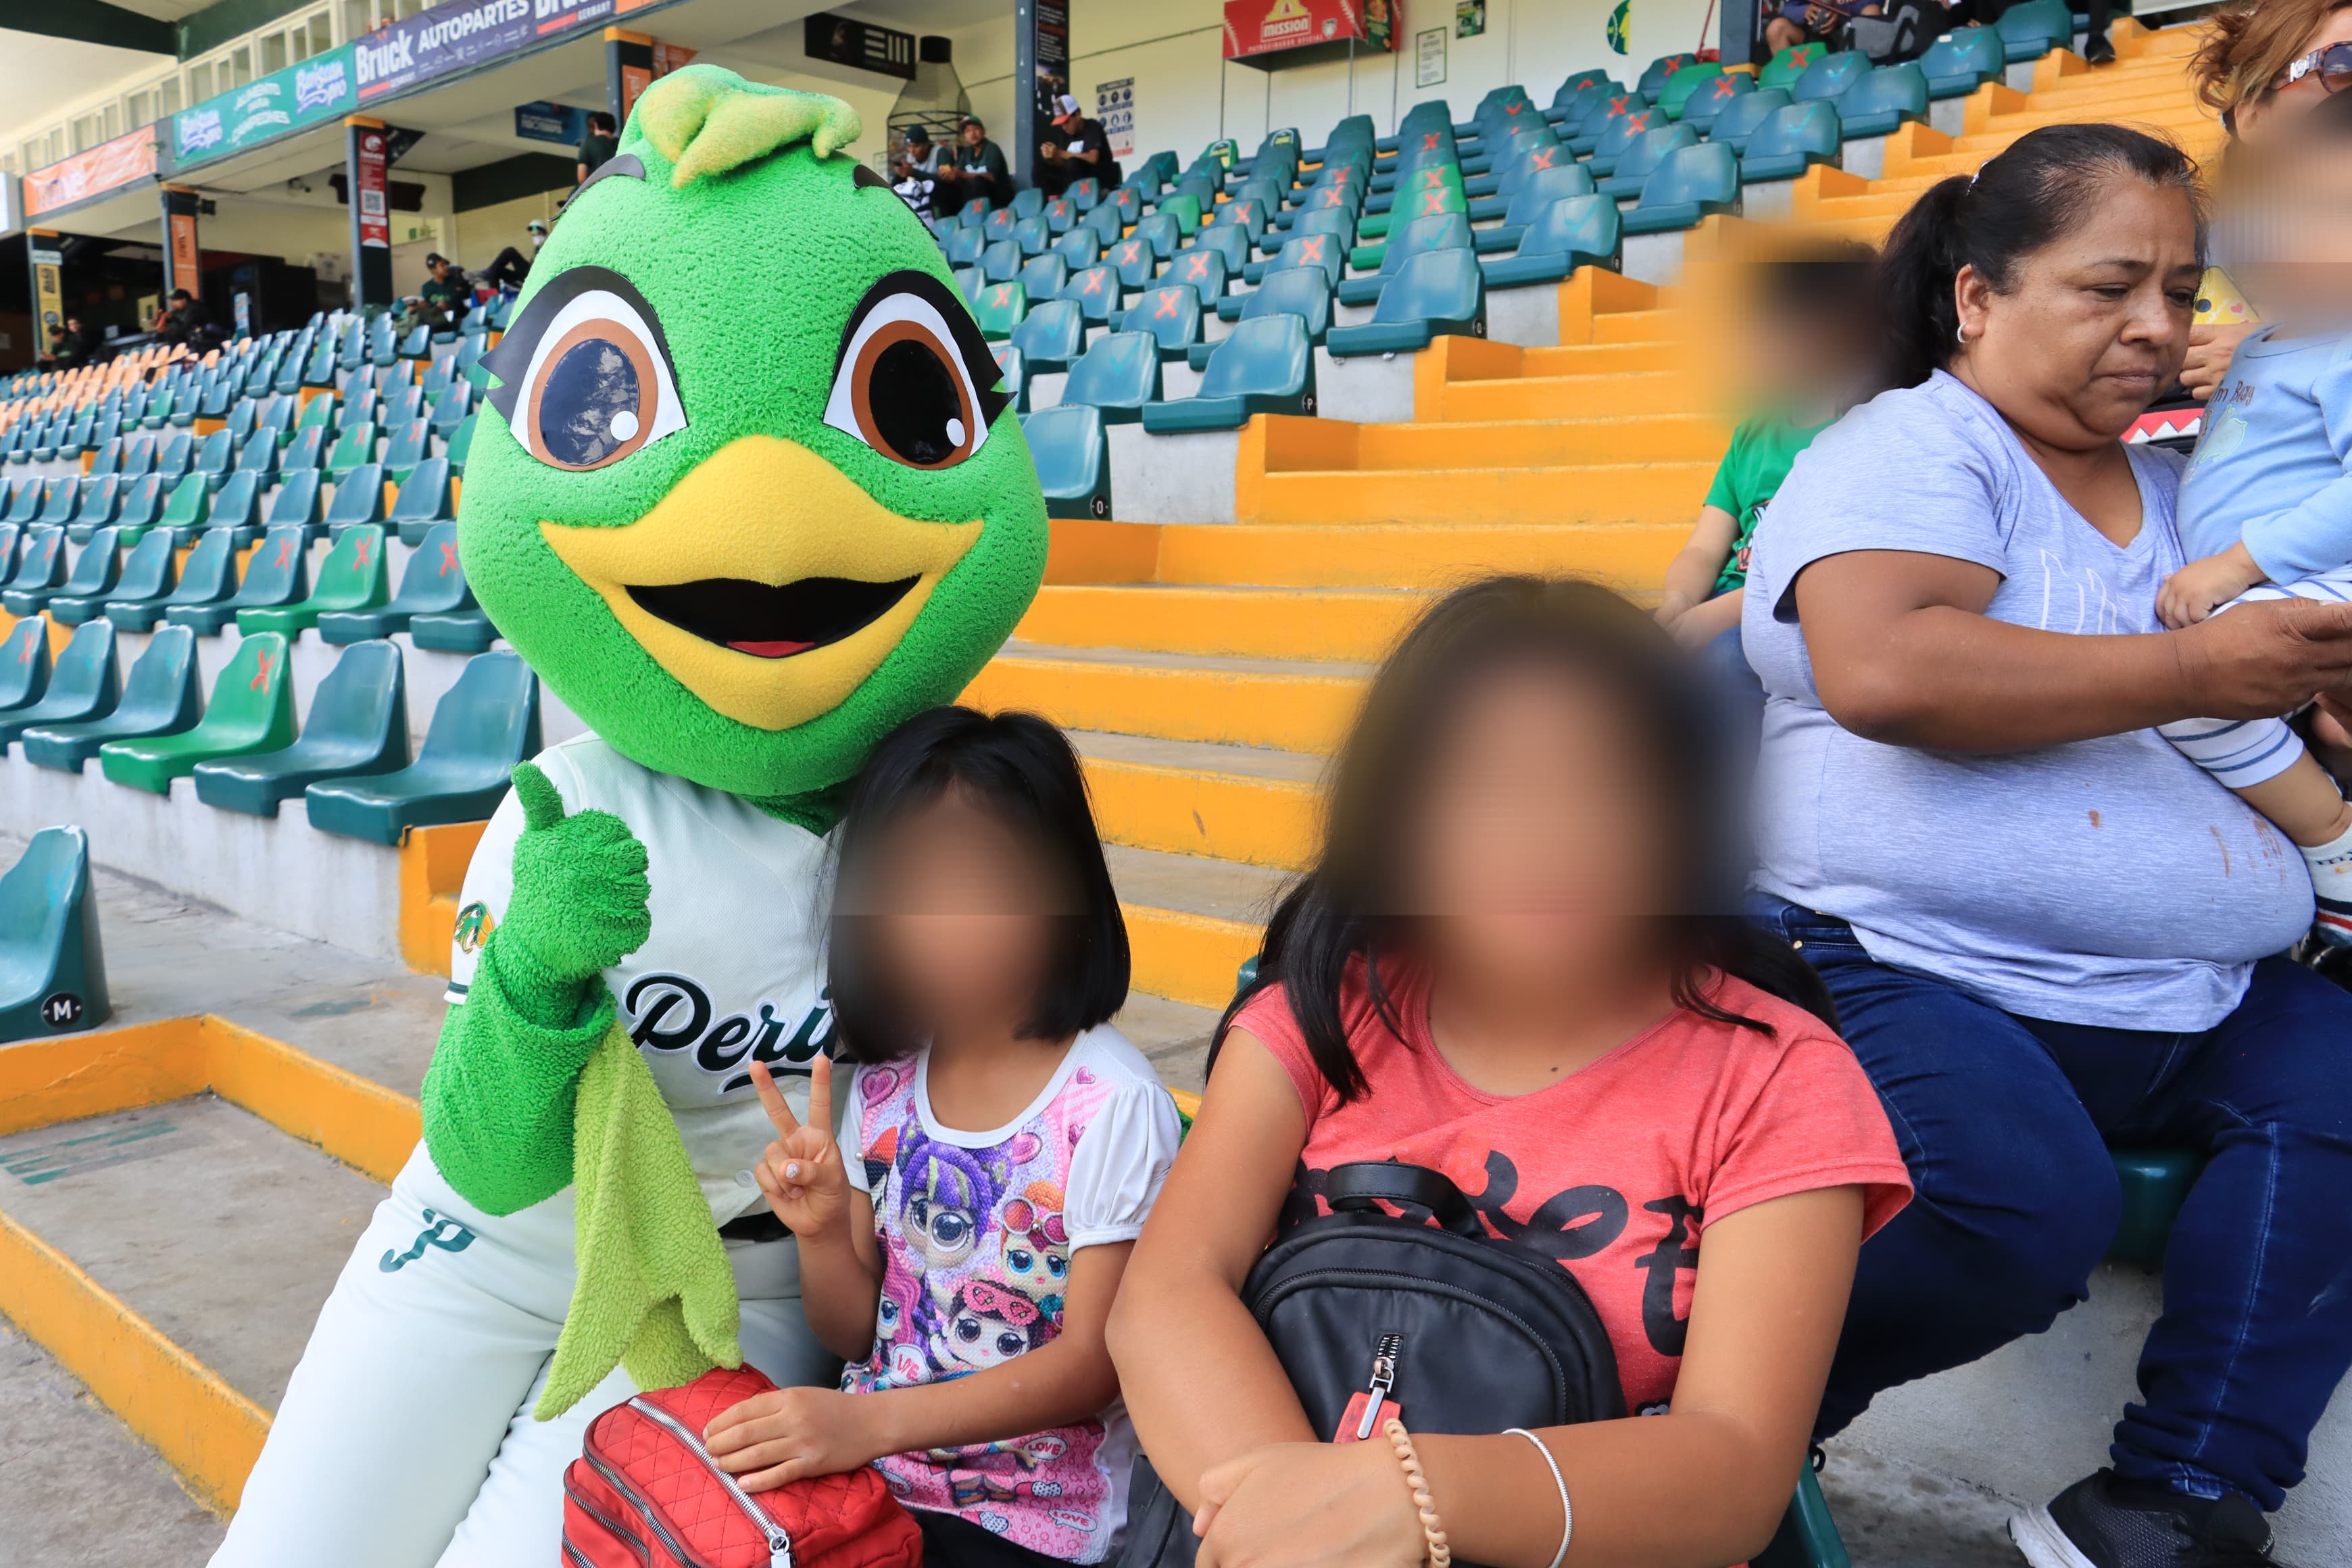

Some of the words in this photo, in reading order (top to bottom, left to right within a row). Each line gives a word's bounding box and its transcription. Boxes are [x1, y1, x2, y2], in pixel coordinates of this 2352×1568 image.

[577, 1, 611, 22] GERMANY
[416, 0, 530, 54] AUTOPARTES
[1264, 18, 1309, 39] MISSION
[1306, 397, 1314, 411] P
[53, 999, 72, 1022] M
[622, 971, 837, 1075] Peri
[1028, 1442, 1062, 1456] LOVE
